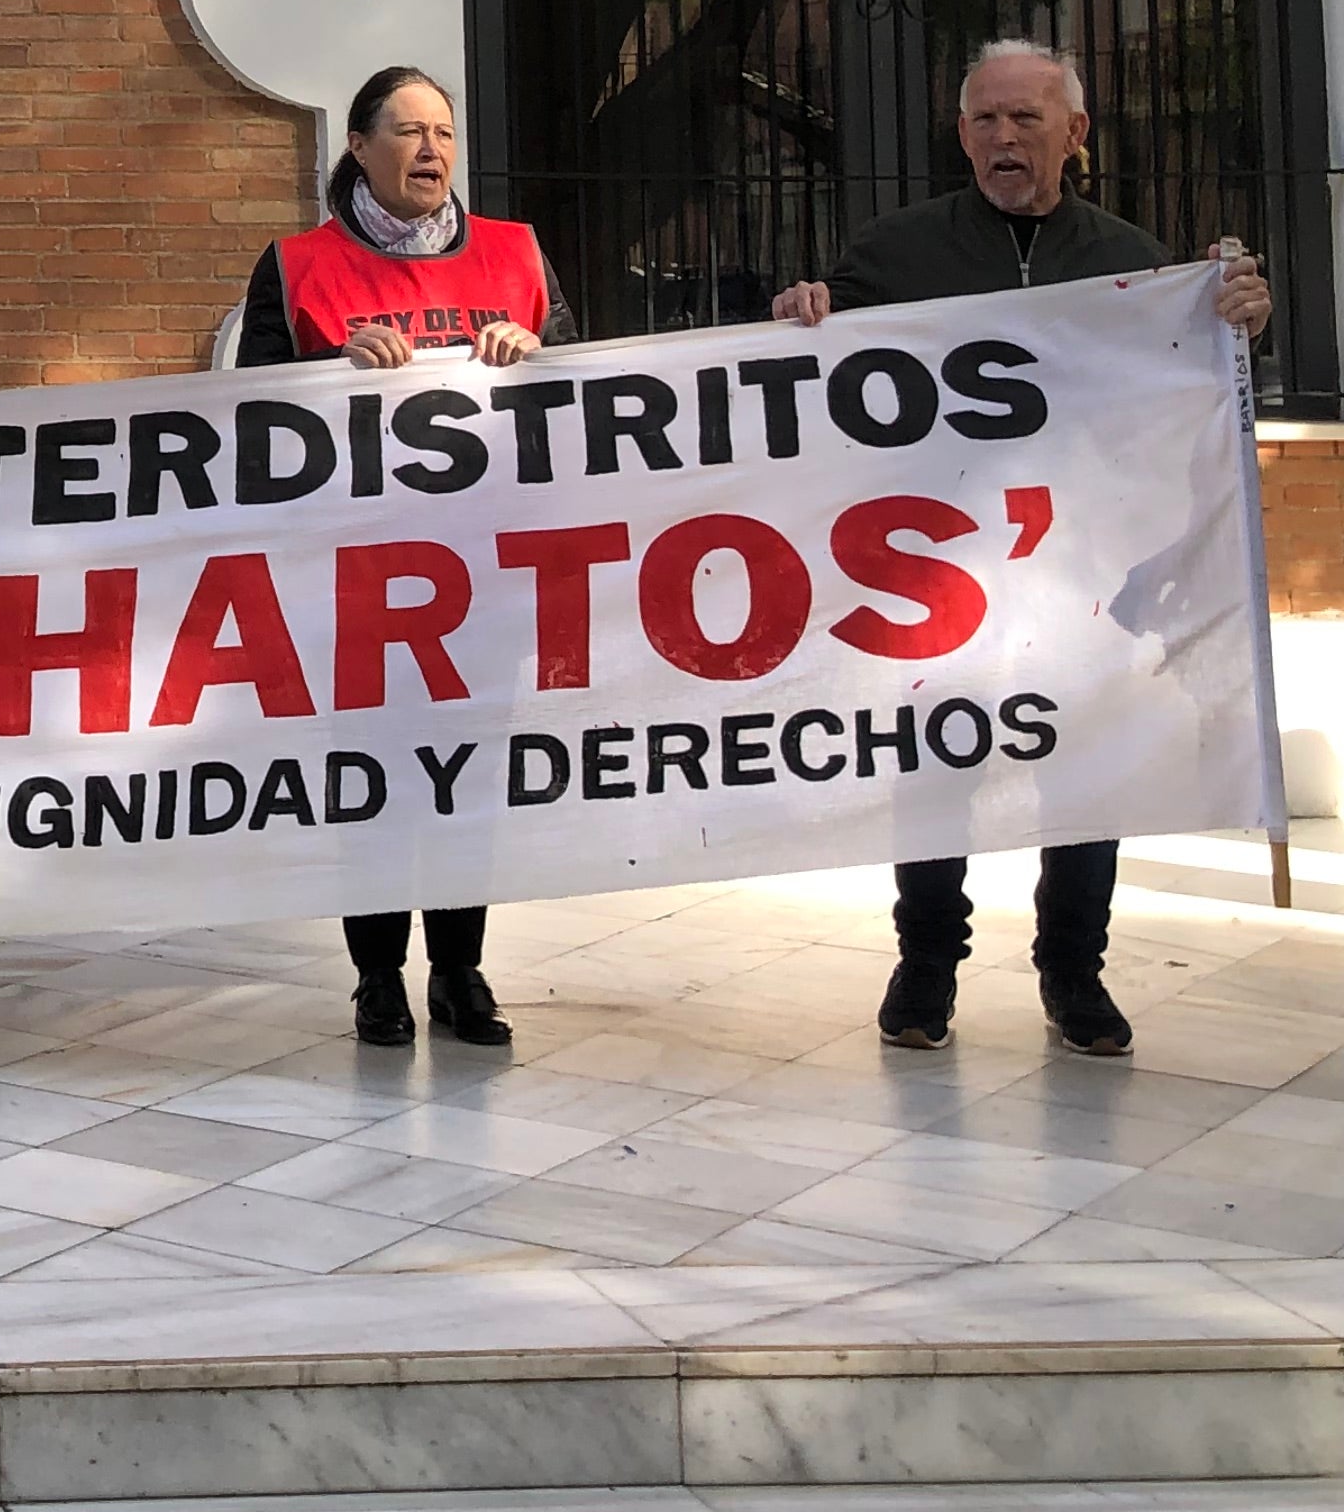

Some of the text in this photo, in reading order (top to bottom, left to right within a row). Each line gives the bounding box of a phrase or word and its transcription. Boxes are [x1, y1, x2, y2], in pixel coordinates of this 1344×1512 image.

[423, 308, 463, 332] DE
[415, 743, 478, 816] Y
[508, 693, 1058, 808] DERECHOS
